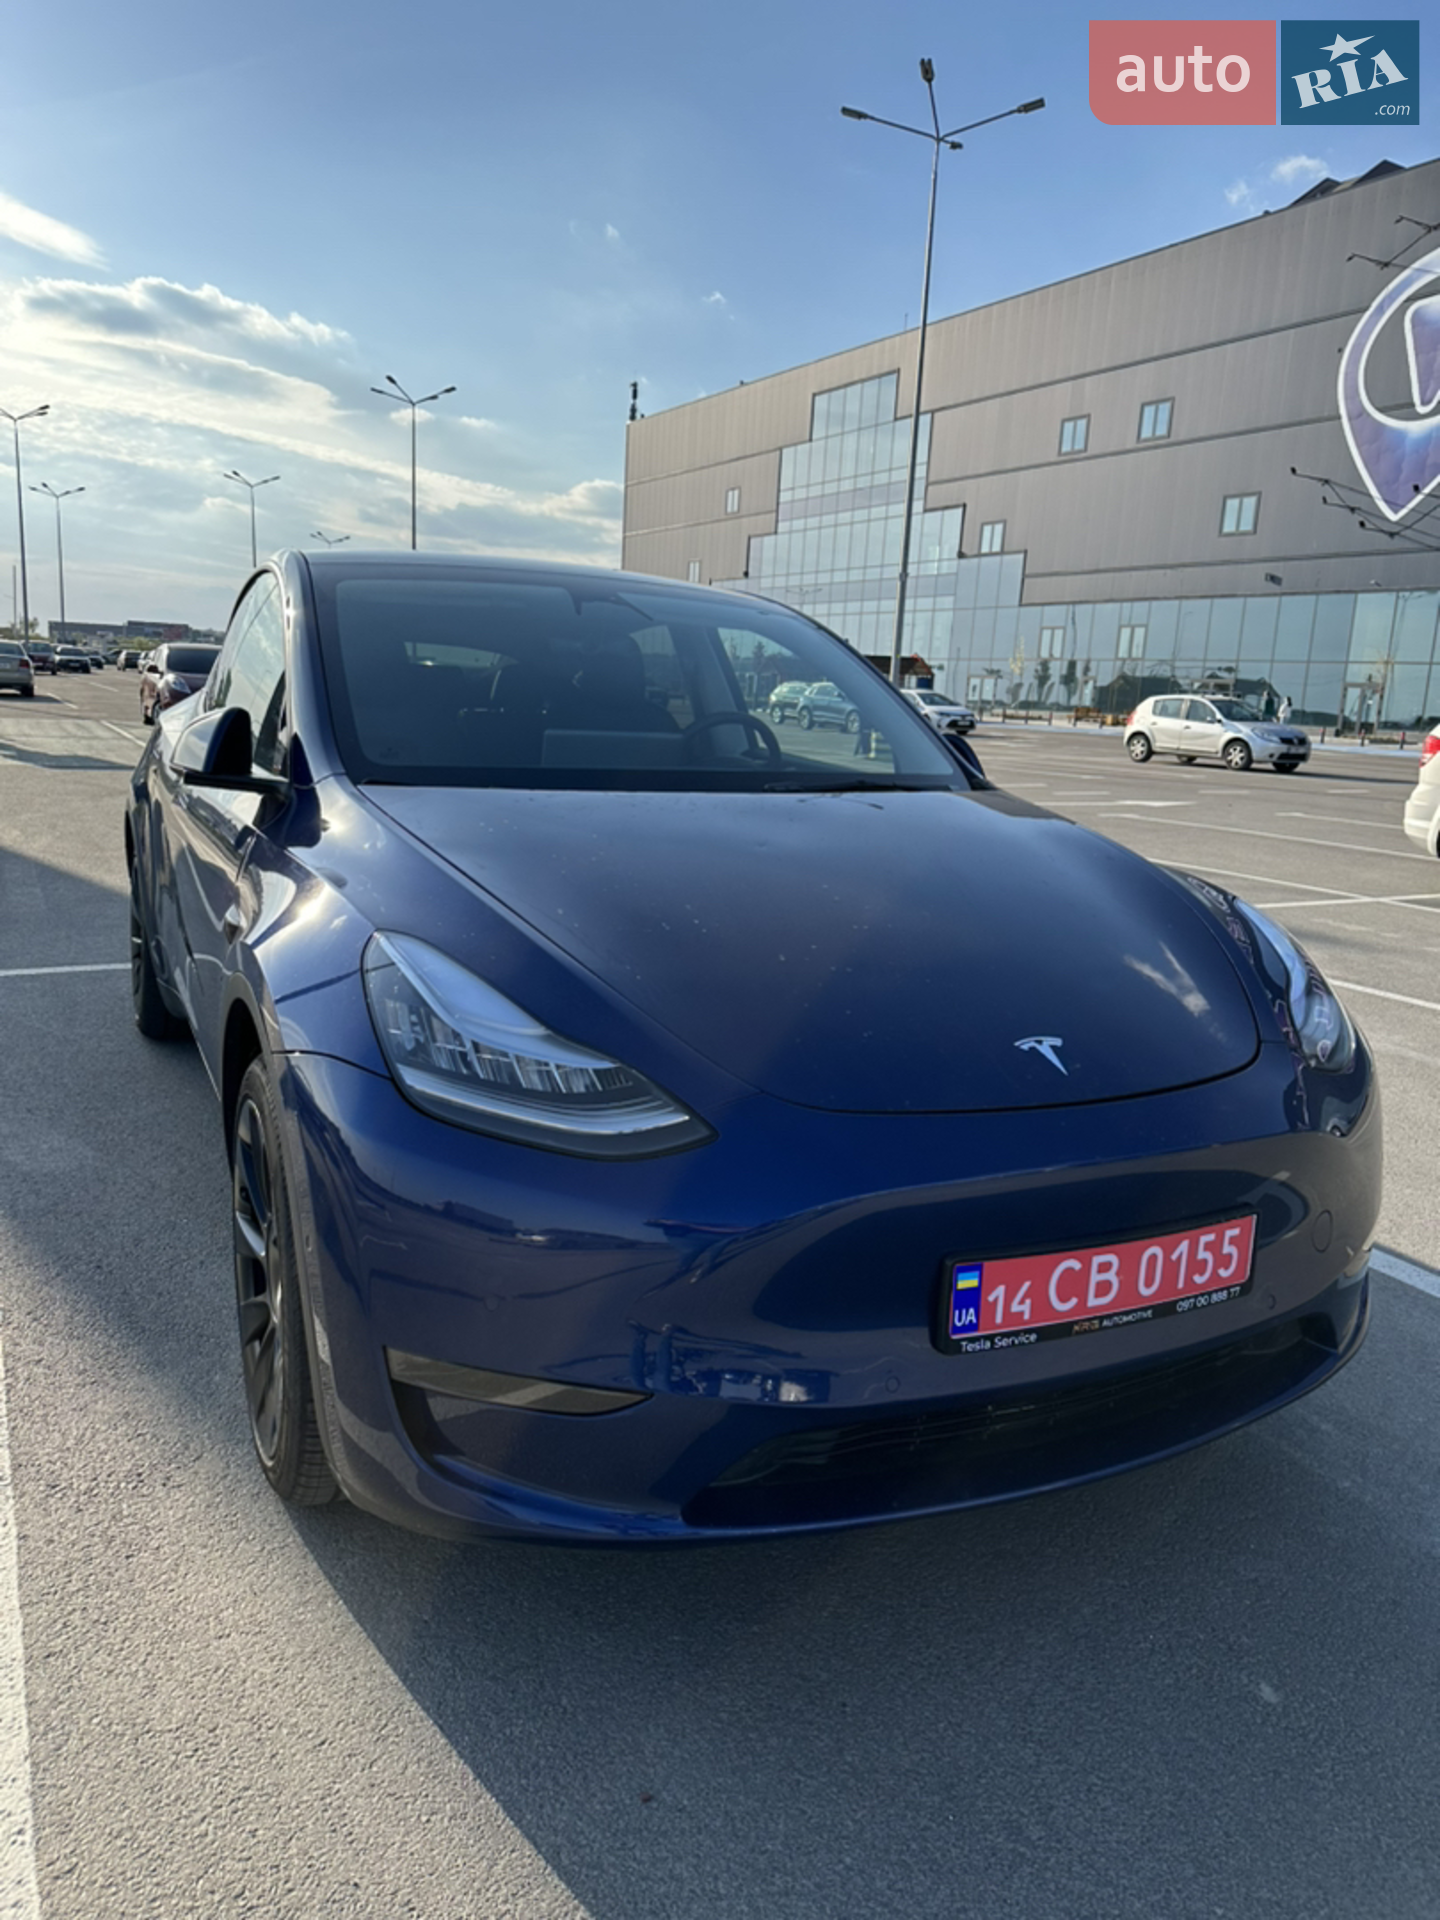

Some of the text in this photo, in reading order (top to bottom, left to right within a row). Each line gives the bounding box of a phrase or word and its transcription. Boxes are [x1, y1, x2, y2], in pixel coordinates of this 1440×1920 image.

[987, 1227, 1241, 1325] 14 CB 0155
[954, 1307, 977, 1327] UA
[1102, 1309, 1153, 1327] AUTOMOTIVE
[960, 1331, 1038, 1353] Tesla Service
